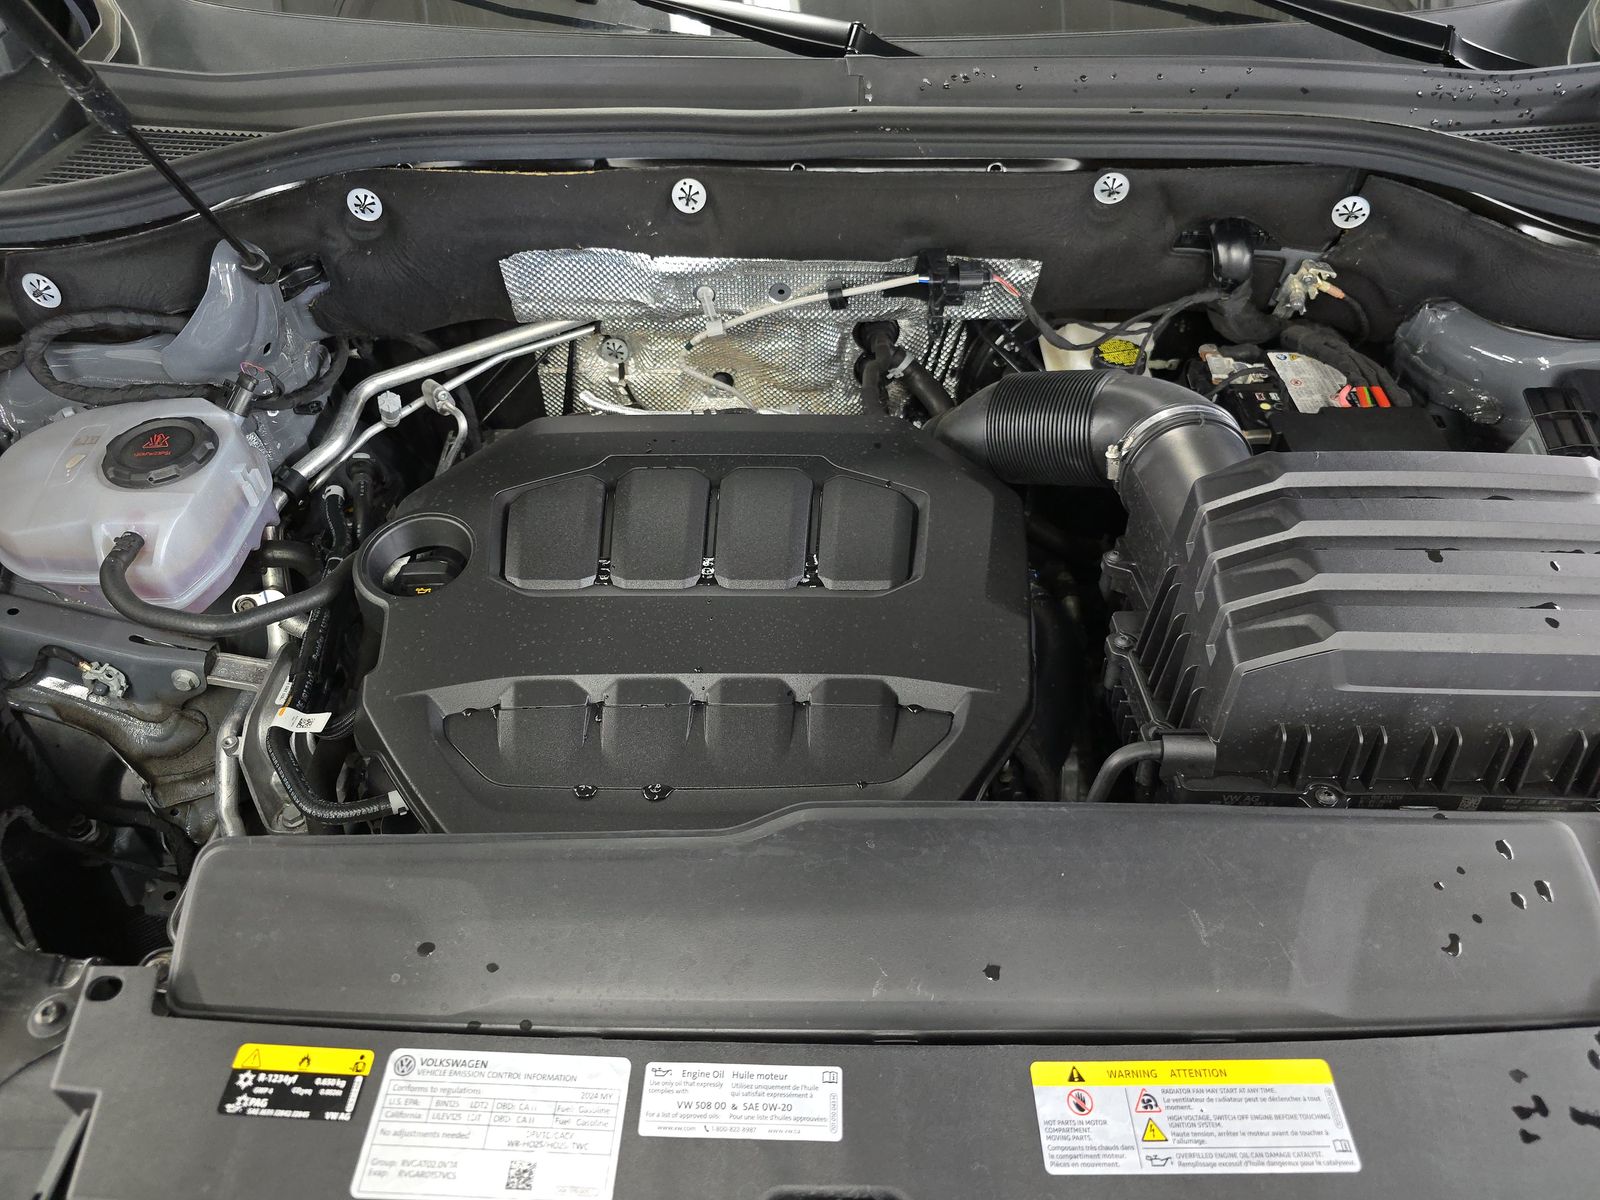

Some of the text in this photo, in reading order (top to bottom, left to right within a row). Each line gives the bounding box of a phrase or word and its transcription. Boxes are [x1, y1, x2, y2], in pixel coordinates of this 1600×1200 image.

[420, 1057, 488, 1069] VOLKSWAGEN
[417, 1068, 577, 1083] VEHICLE EMISSION CONTROL INFORMATION
[682, 1069, 724, 1080] Engine Oil
[732, 1071, 788, 1081] Huile moteur
[1107, 1068, 1227, 1079] WARNING ATTENTION
[392, 1084, 428, 1092] Conforms
[662, 1080, 674, 1088] only
[697, 1081, 724, 1089] expressly
[731, 1082, 753, 1090] Utilisez
[755, 1084, 791, 1092] uniquement
[249, 1097, 269, 1108] PAG
[677, 1101, 693, 1109] VW
[696, 1101, 712, 1110] 508
[714, 1101, 727, 1110] 00
[743, 1102, 759, 1111] SAE
[762, 1103, 793, 1112] 0W-20
[679, 1112, 707, 1120] approved
[380, 1128, 391, 1136] No
[392, 1128, 440, 1139] adjustments
[1047, 1144, 1085, 1152] Composants
[1056, 1153, 1100, 1161] compartiment
[1178, 1160, 1217, 1168] Remplissage
[1266, 1160, 1298, 1168] dangereux
